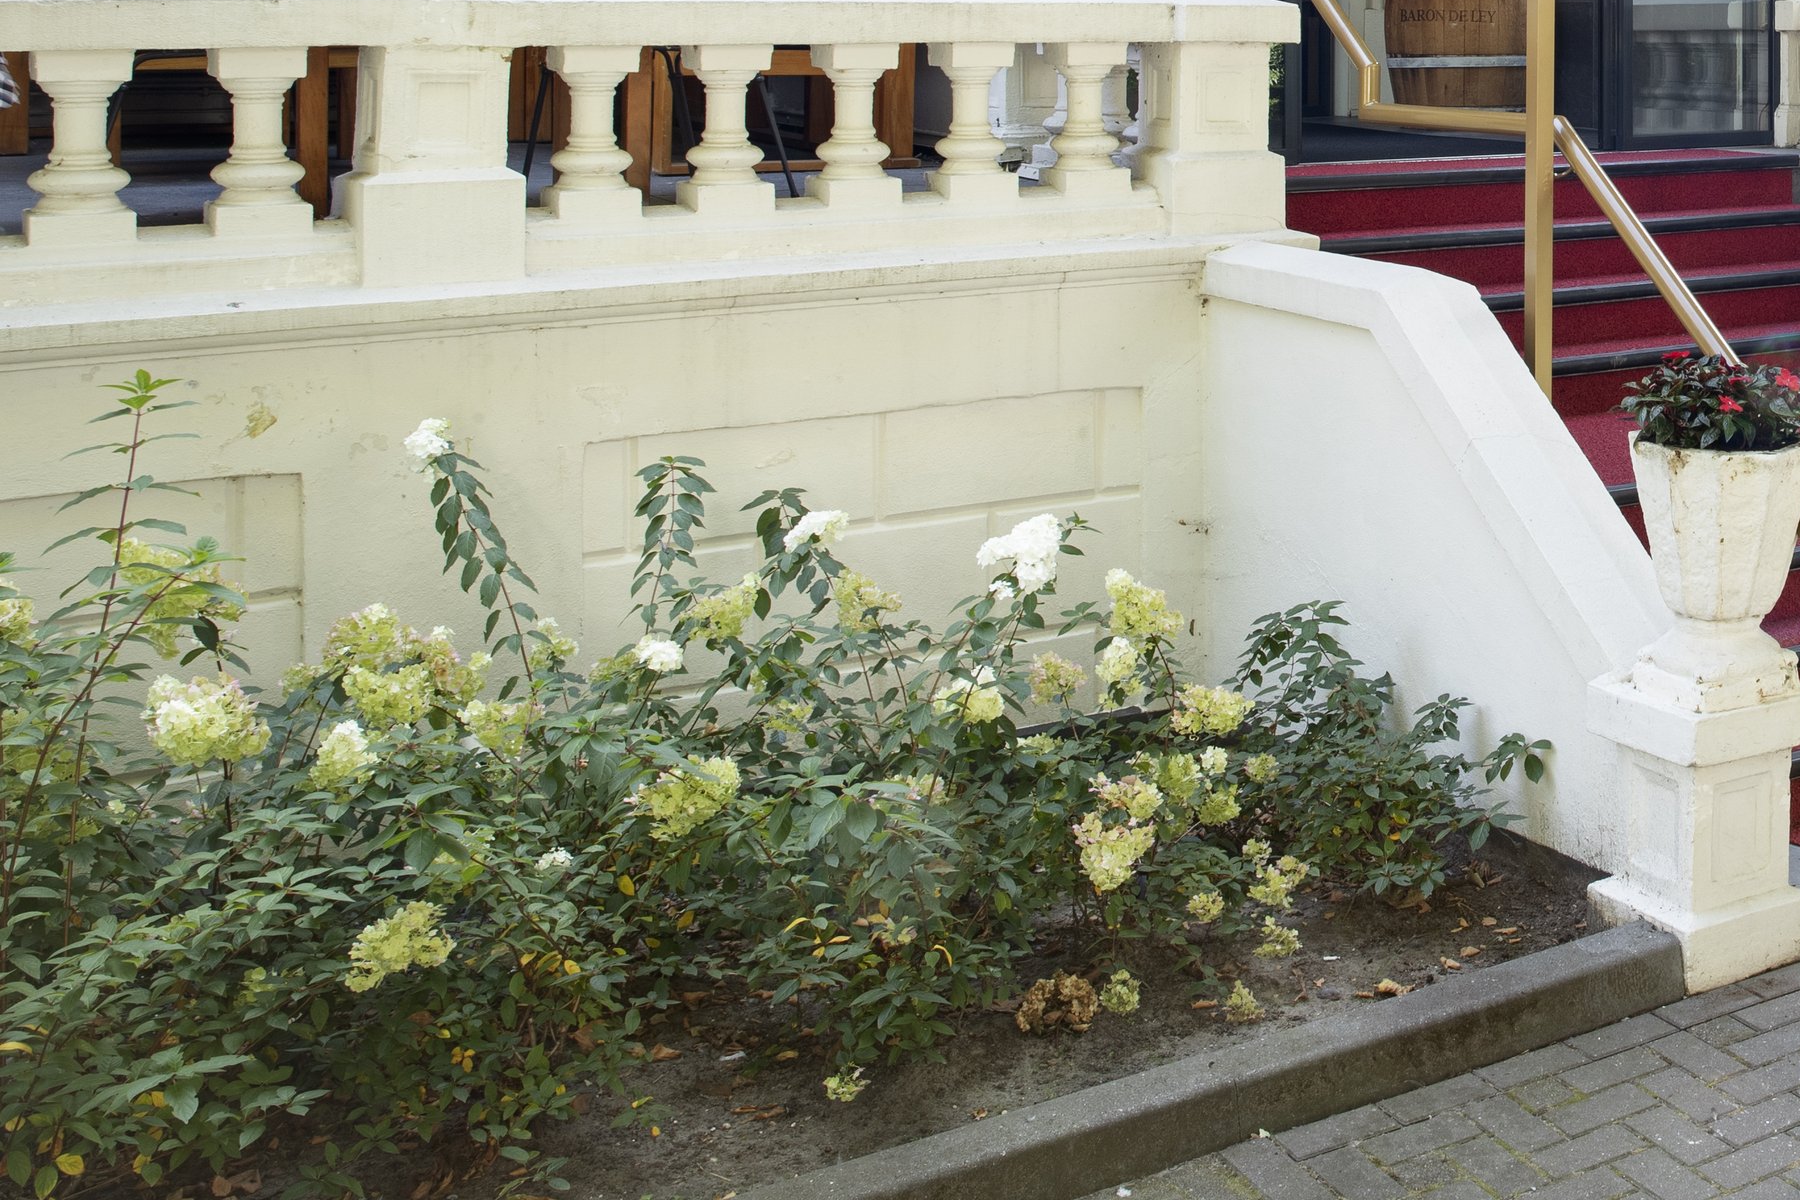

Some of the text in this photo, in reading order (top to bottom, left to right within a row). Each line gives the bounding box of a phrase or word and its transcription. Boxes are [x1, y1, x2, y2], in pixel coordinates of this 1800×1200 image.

[1399, 8, 1497, 24] BARON DE LEY
